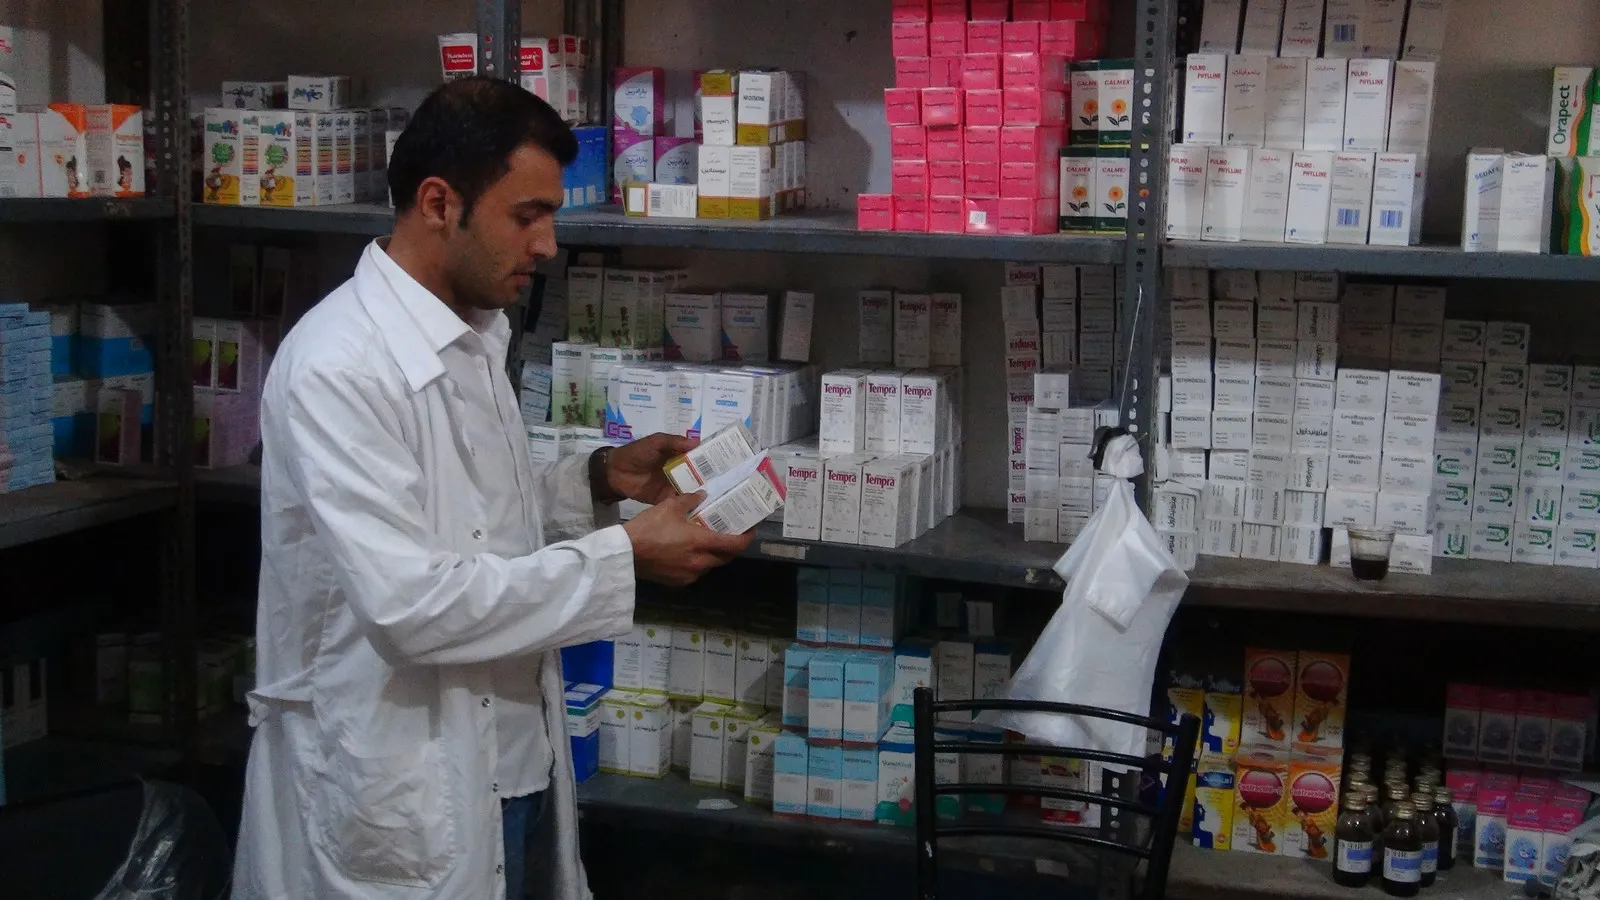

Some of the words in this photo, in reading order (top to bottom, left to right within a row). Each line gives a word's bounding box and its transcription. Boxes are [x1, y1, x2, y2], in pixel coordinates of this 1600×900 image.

[1553, 85, 1571, 144] Orapect
[862, 297, 888, 308] Tempra
[900, 301, 927, 312] Tempra
[1009, 338, 1038, 350] Tempra
[1008, 358, 1036, 370] Tempra
[824, 383, 852, 397] Tempra
[868, 383, 897, 397] Tempra
[904, 385, 932, 398] Tempra
[1009, 392, 1035, 404] Tempr
[1013, 427, 1024, 456] Tempra
[788, 465, 817, 479] Tempra
[827, 469, 857, 484] Tempra
[865, 473, 896, 488] Tempra
